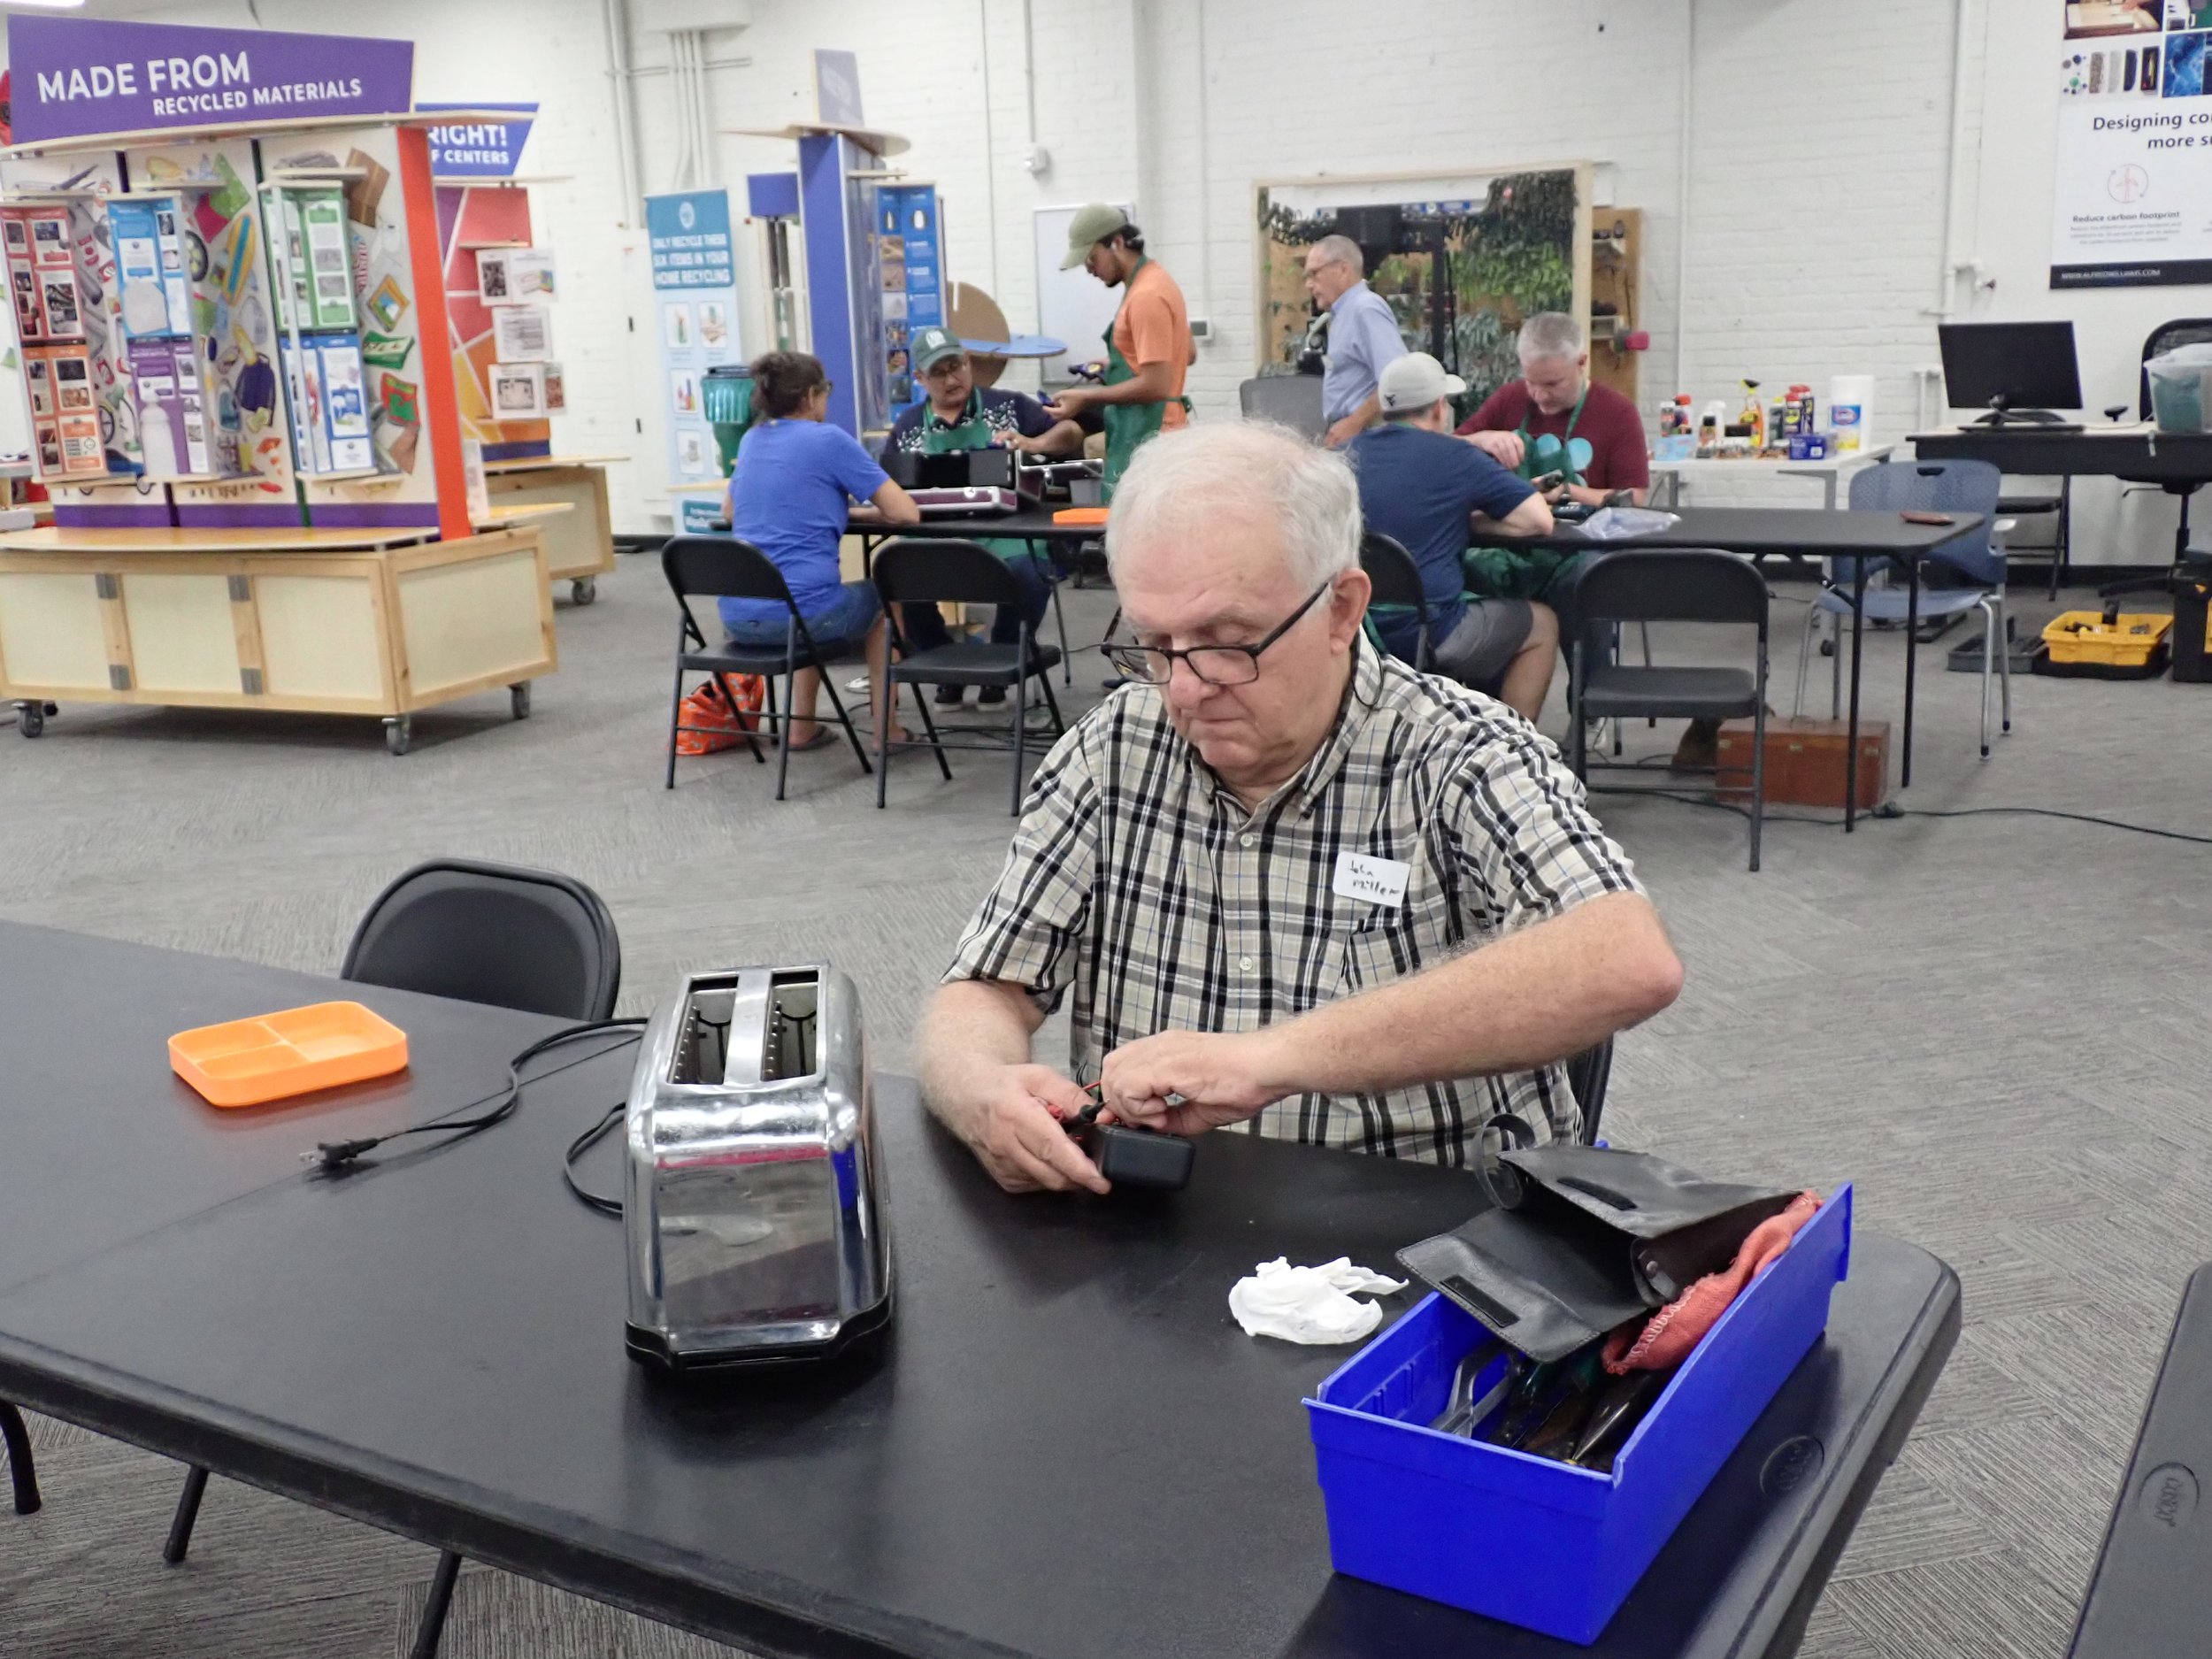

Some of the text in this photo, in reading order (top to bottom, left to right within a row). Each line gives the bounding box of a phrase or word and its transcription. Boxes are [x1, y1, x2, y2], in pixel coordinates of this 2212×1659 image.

[36, 50, 250, 104] MADE FROM
[153, 77, 364, 116] RECYCLED MATERIALS
[2093, 111, 2212, 133] Designing co
[427, 124, 507, 146] RIGHT!
[2147, 134, 2212, 150] more s
[444, 150, 509, 164] CENTERS
[2107, 212, 2138, 221] carbon
[2139, 211, 2180, 221] footprint
[671, 234, 703, 248] RECYCLE
[703, 233, 727, 246] THESE
[669, 251, 693, 265] ITEMS
[694, 251, 704, 265] IN
[705, 250, 730, 264] YOUR
[655, 268, 731, 284] HOME RECYCLING
